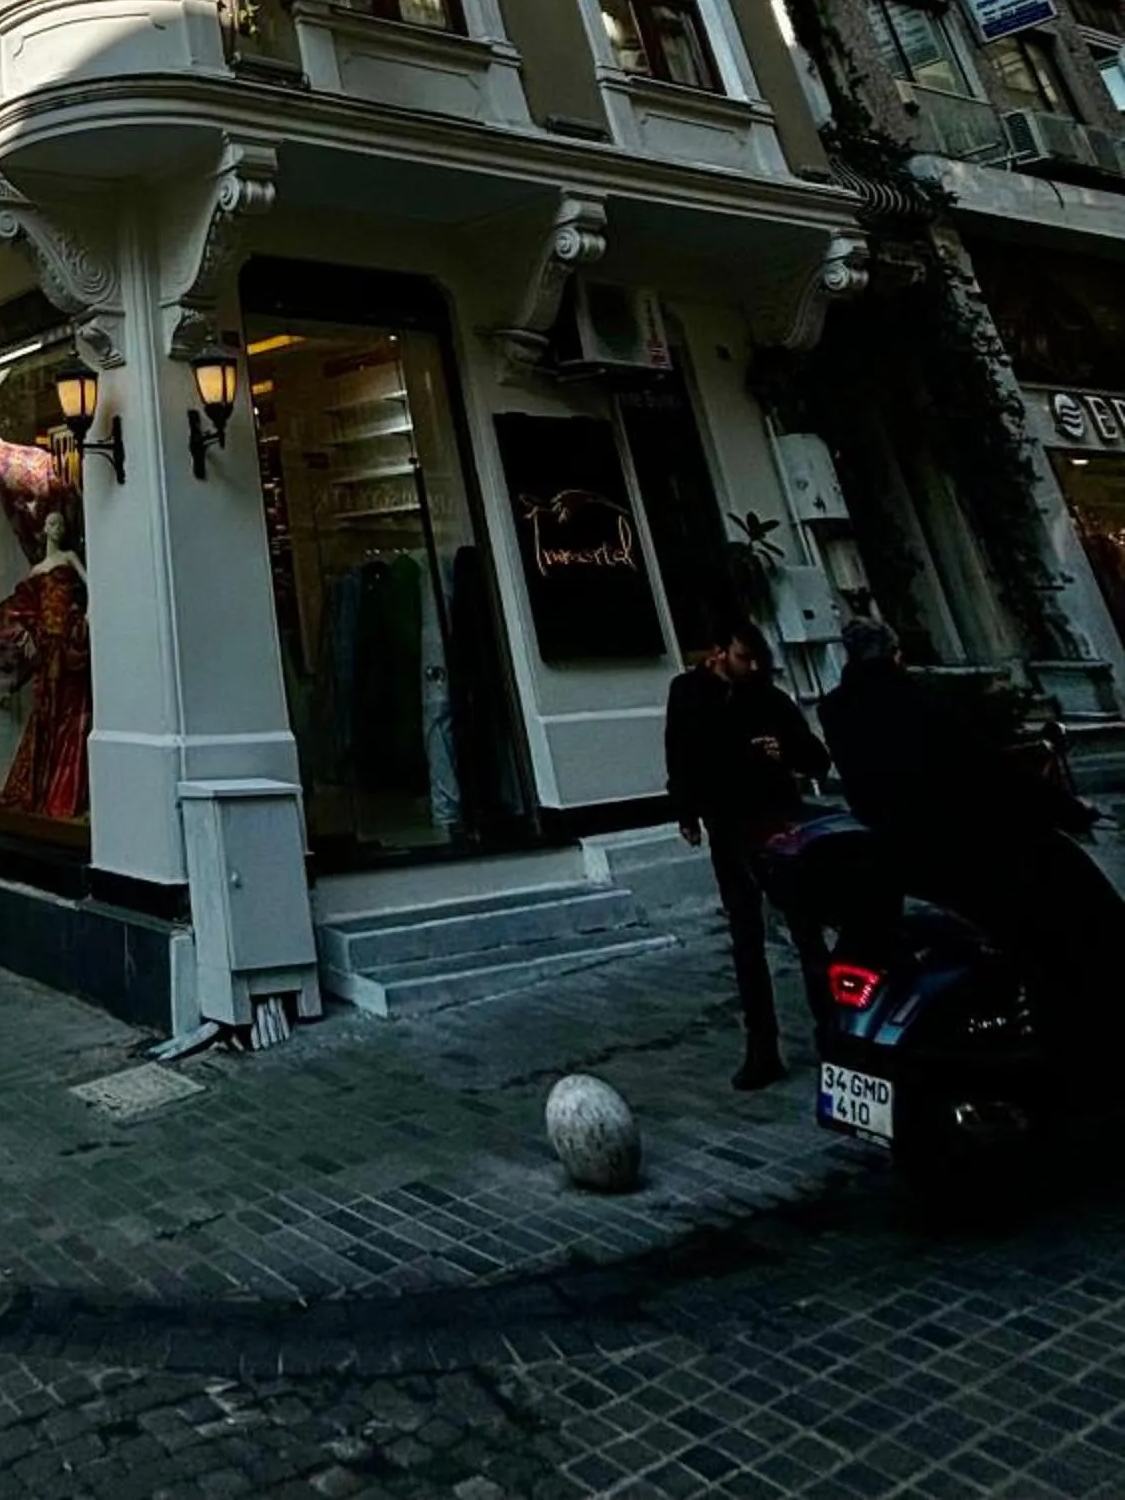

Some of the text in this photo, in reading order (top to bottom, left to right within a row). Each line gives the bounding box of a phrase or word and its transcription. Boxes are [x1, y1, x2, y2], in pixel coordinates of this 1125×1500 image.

[825, 1066, 889, 1105] 34 GMD
[837, 1096, 870, 1125] 410
